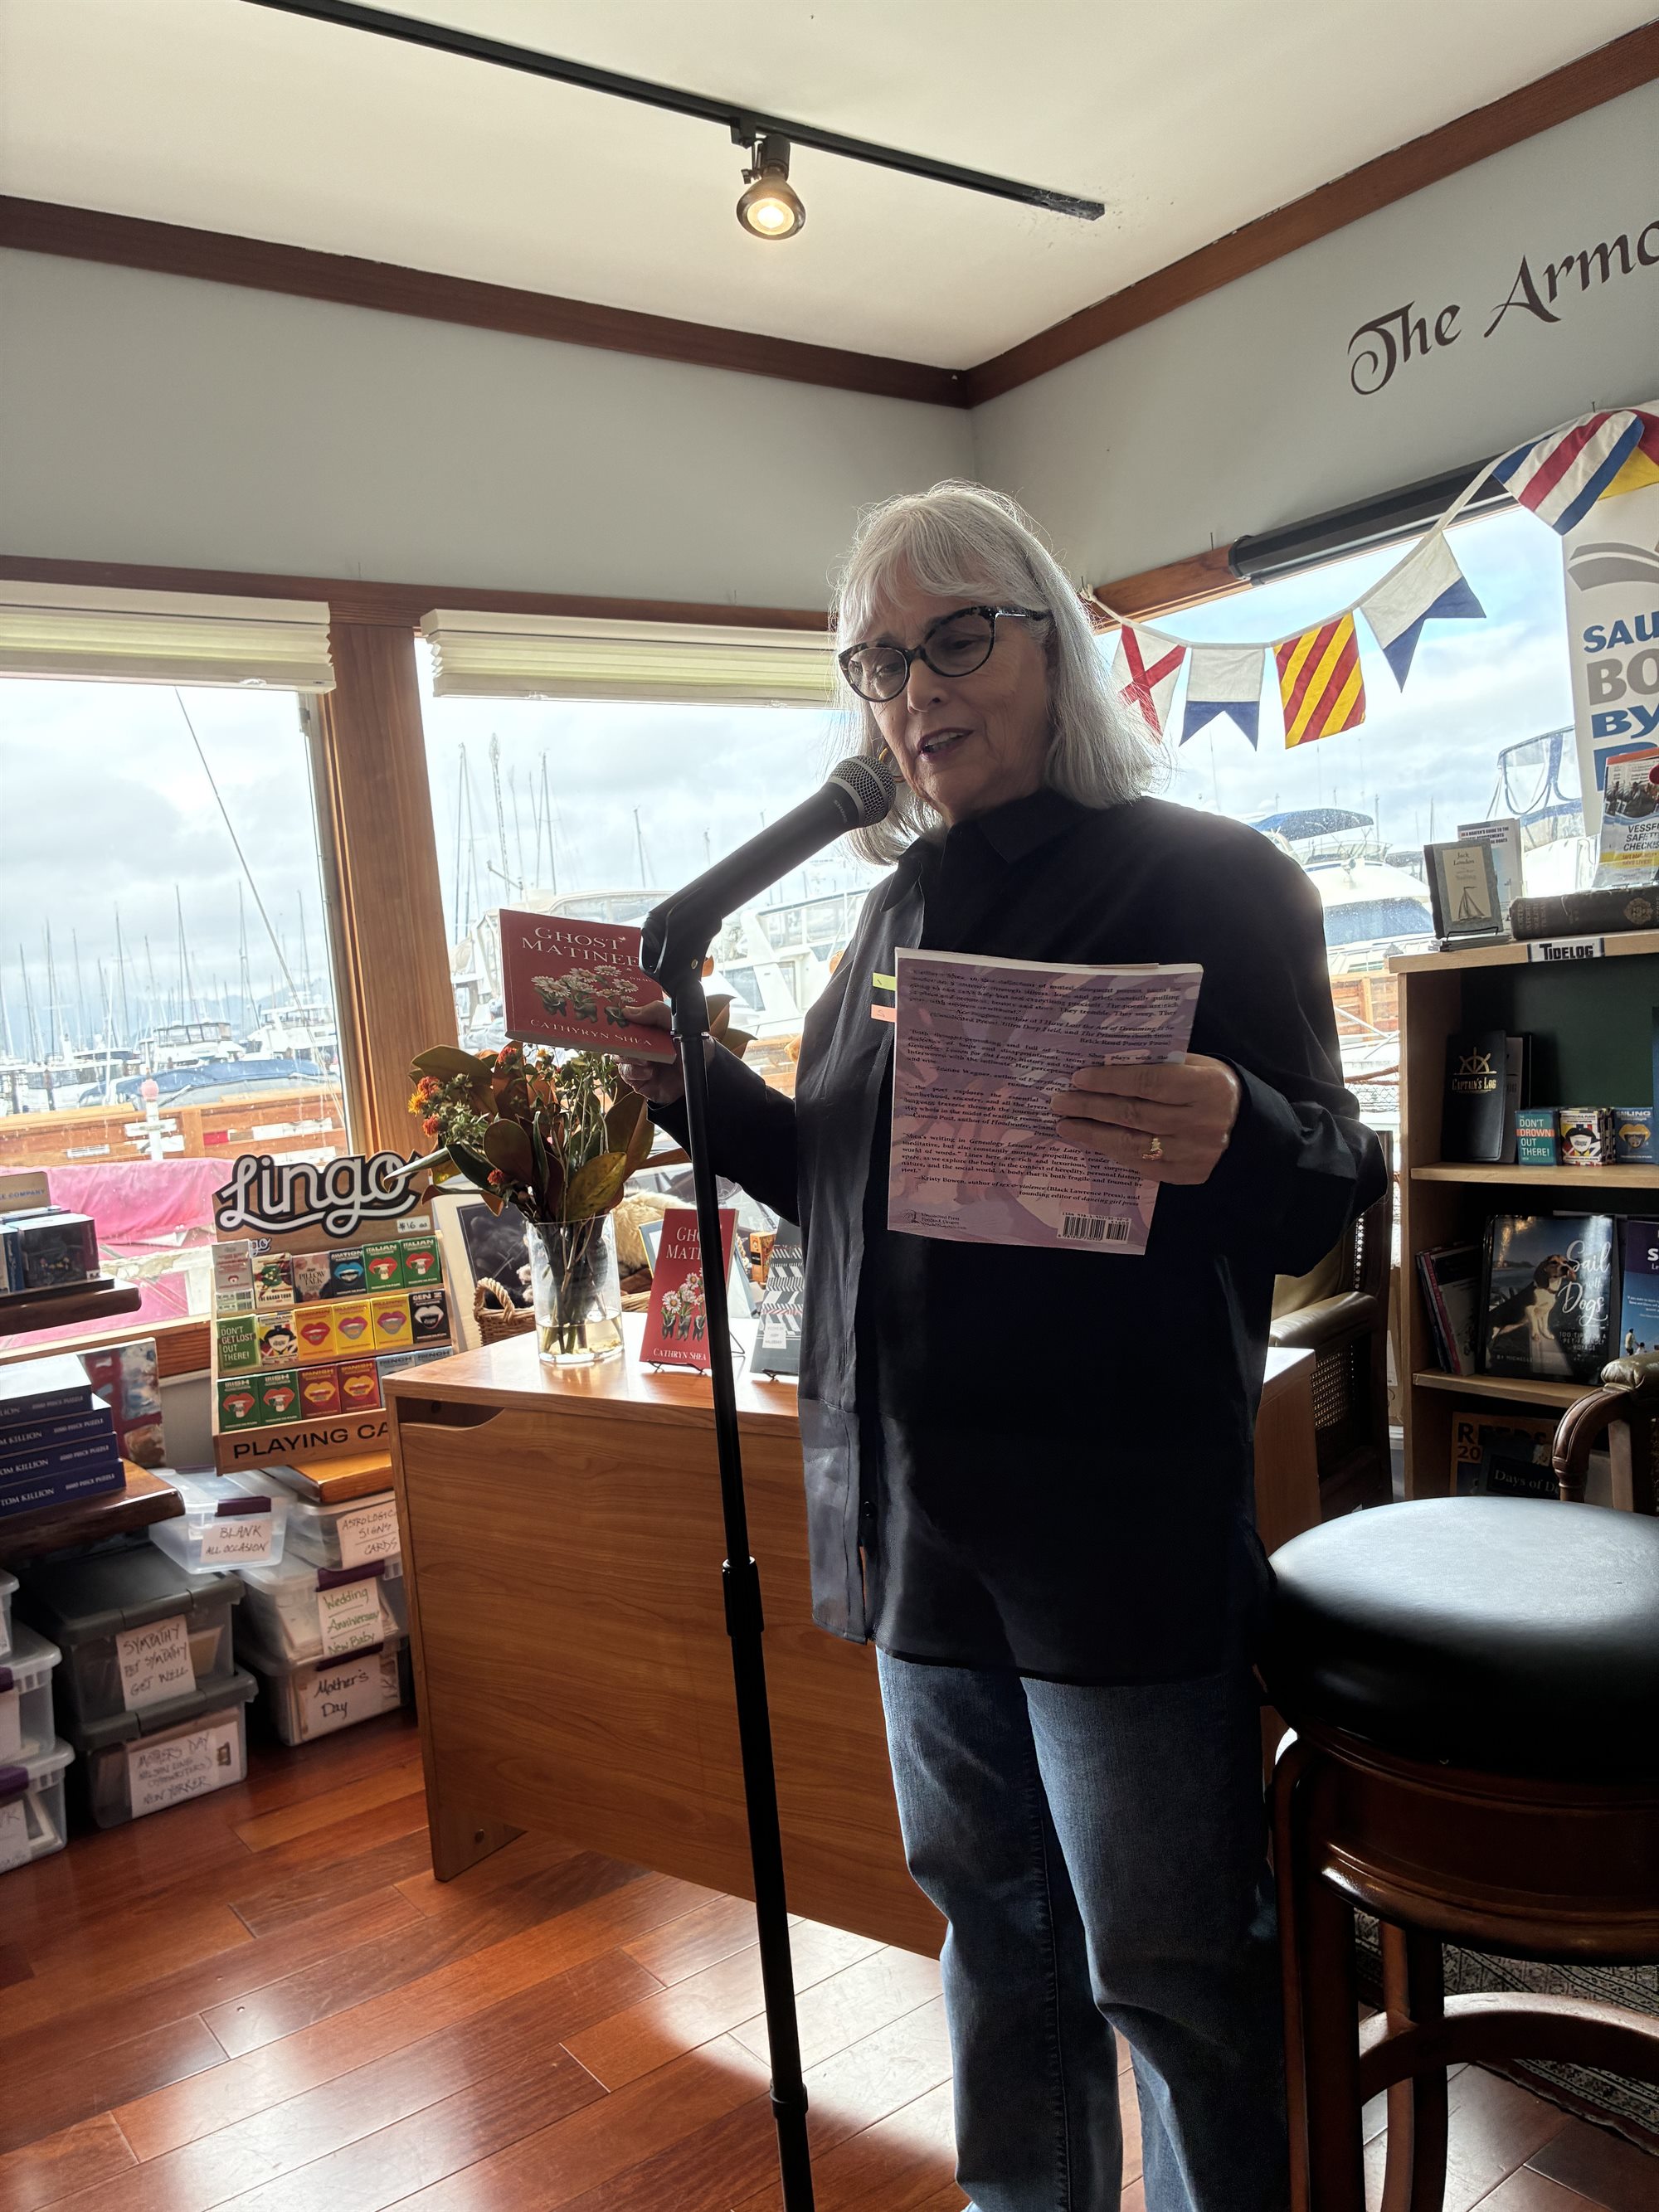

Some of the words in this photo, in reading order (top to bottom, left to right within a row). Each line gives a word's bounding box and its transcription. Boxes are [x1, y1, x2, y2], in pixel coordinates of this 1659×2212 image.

[1347, 300, 1462, 395] The
[1583, 610, 1659, 654] SAU
[1586, 648, 1659, 706] BO
[534, 927, 622, 950] GHOST
[522, 937, 640, 967] MATINEE
[1540, 943, 1593, 960] TIDELOG
[615, 1033, 652, 1046] SHEA
[1519, 1118, 1545, 1128] DON'T
[1520, 1128, 1551, 1137] DROWN
[902, 1140, 940, 1149] meditative,
[973, 1145, 1009, 1154] constantly
[1520, 1137, 1537, 1147] OUT
[1521, 1147, 1550, 1157] THERE!
[1007, 1169, 1024, 1178] body
[1068, 1174, 1092, 1183] fragile
[216, 1151, 420, 1237] Lingo
[1019, 1190, 1050, 1198] founding
[1081, 1195, 1110, 1204] dancing
[1069, 1188, 1102, 1196] Lawrence
[366, 1243, 397, 1254] ITALIAN
[402, 1238, 434, 1249] ITALIAN
[1566, 1240, 1612, 1273] Sail
[299, 1271, 325, 1281] PILLOW
[305, 1278, 323, 1286] TALK
[412, 1292, 431, 1301] GEN
[1557, 1281, 1609, 1327] Dogs
[221, 1325, 244, 1335] DON'T
[221, 1335, 237, 1344] GET
[236, 1333, 253, 1343] LOST
[222, 1344, 238, 1354] OUT
[224, 1351, 250, 1361] THERE!
[653, 1347, 688, 1359] CATHRYN
[689, 1351, 707, 1361] SHEA
[340, 1362, 373, 1373] SPANISH
[224, 1379, 250, 1388] IRISH
[265, 1373, 289, 1383] IRISH
[0, 1407, 21, 1417] LION
[8, 1431, 43, 1445] KILLION
[233, 1428, 348, 1459] PLAYING
[0, 1466, 14, 1476] OM
[16, 1458, 49, 1473] KILLION
[1494, 1469, 1525, 1487] Days
[1529, 1479, 1544, 1491] of
[1, 1495, 21, 1508] TOM
[21, 1487, 55, 1503] KILLION
[343, 1510, 397, 1530] ASTROLOGIC
[219, 1525, 262, 1539] BLANK
[206, 1546, 221, 1555] ALL
[222, 1541, 269, 1553] OCCASION
[364, 1536, 397, 1555] CARDS
[323, 1588, 369, 1610] Wedding
[124, 1623, 180, 1656] SYMPATHY
[328, 1641, 348, 1655] New
[349, 1631, 375, 1647] Baby
[144, 1641, 187, 1670] SYMPATHY
[130, 1675, 153, 1696] GET
[158, 1666, 189, 1683] WELL
[314, 1669, 369, 1699] Mother's
[321, 1701, 348, 1719] Day
[187, 1732, 210, 1753] DAY
